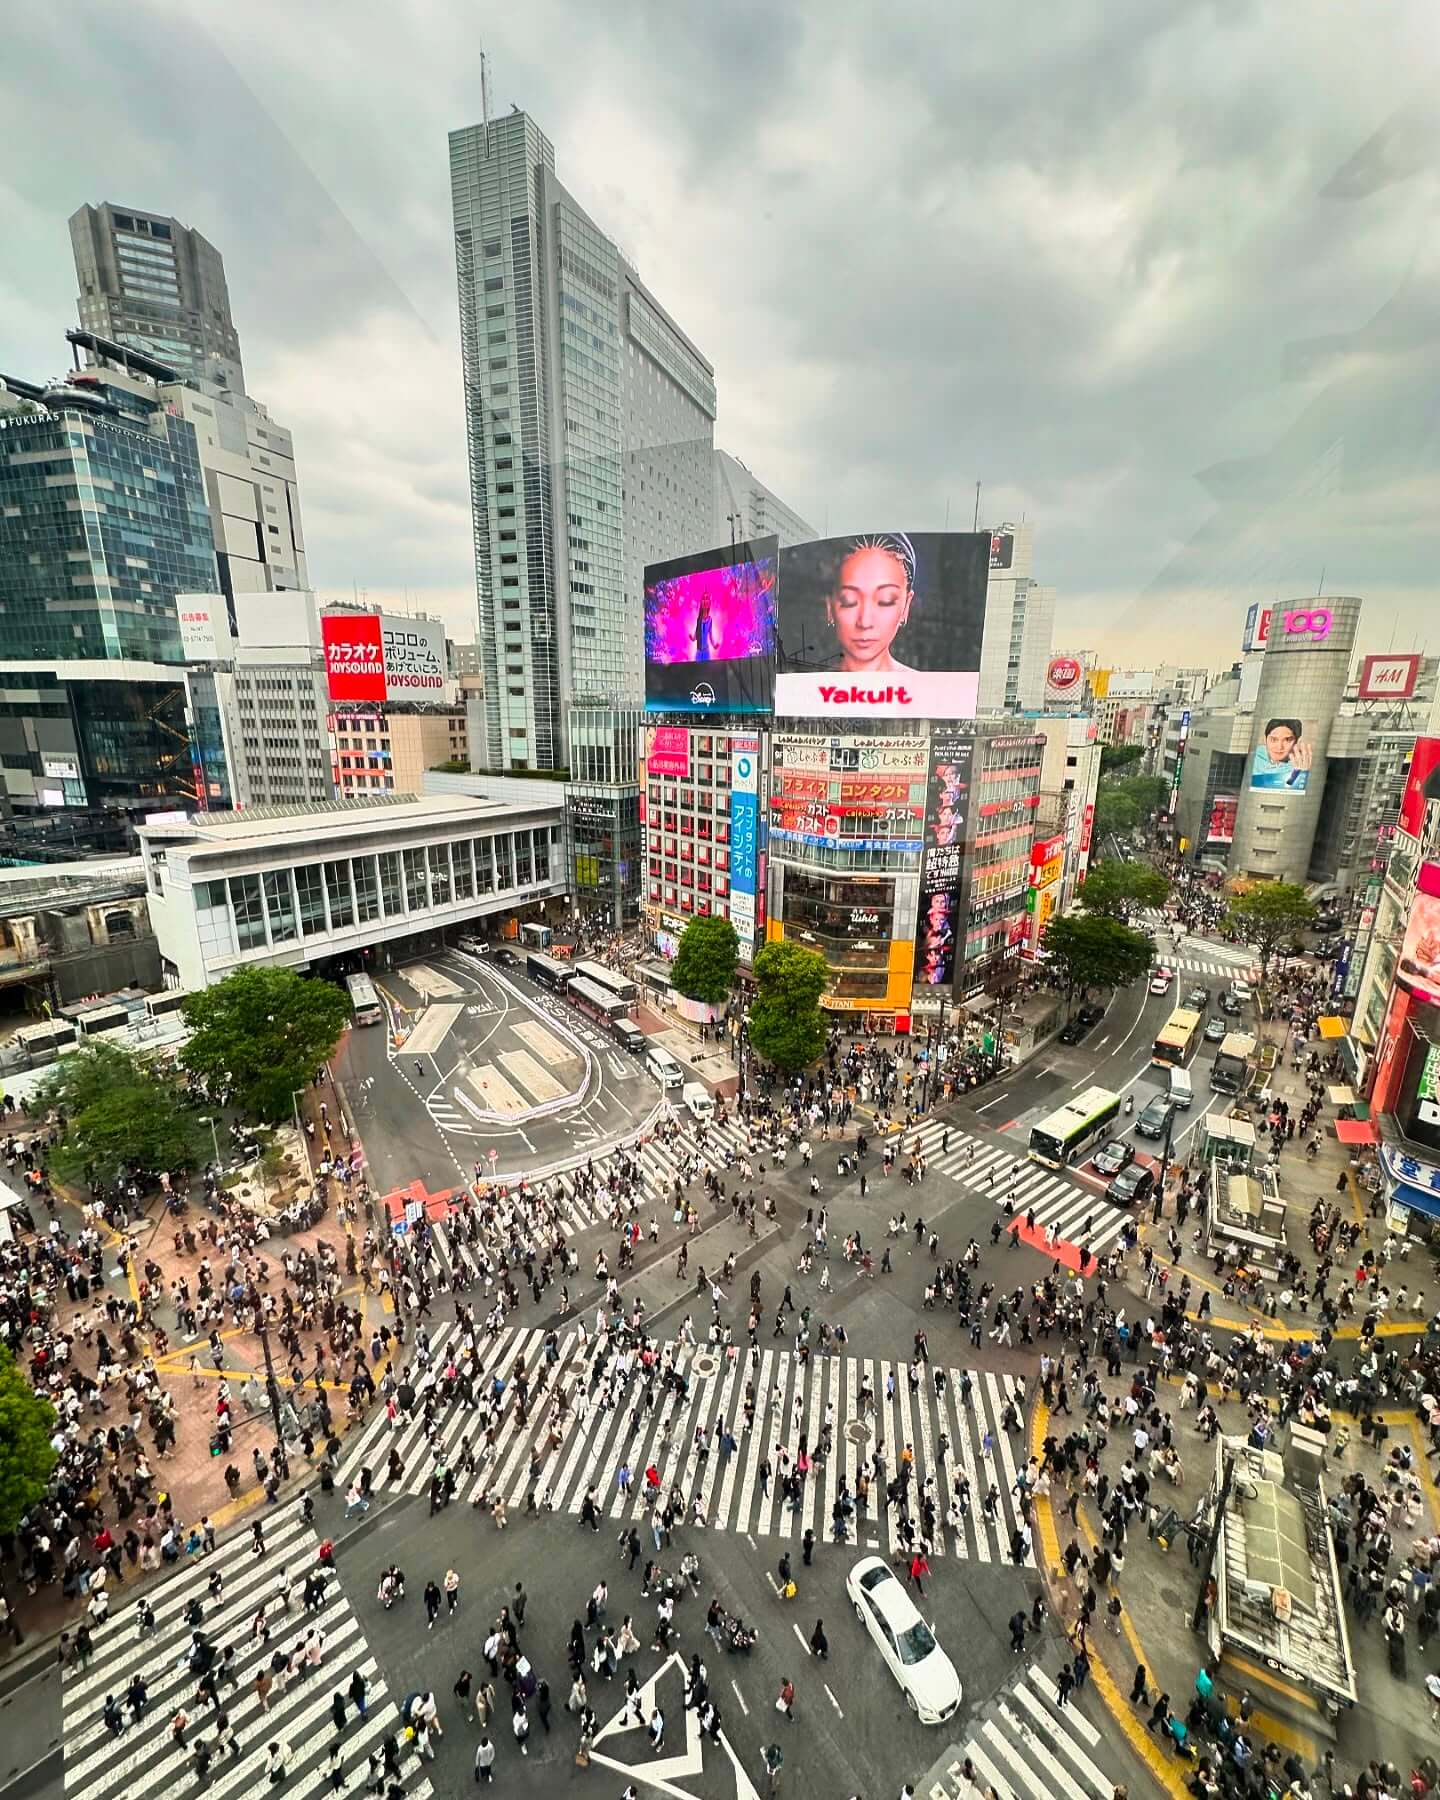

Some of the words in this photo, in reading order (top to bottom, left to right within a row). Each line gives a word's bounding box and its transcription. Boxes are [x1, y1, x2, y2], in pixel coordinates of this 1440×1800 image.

[10, 412, 60, 428] FUKURAS
[1283, 608, 1333, 641] 109
[328, 642, 379, 661] カラオケ
[330, 662, 382, 675] JOYSOUND
[386, 674, 443, 689] JOYSOUND
[818, 686, 912, 704] Yakult
[842, 785, 906, 798] コンタクト
[807, 803, 830, 817] ガスト
[885, 808, 916, 820] ガスト
[796, 815, 823, 833] ガスト
[733, 804, 745, 877] アイシティ
[745, 806, 754, 879] コンタクトの
